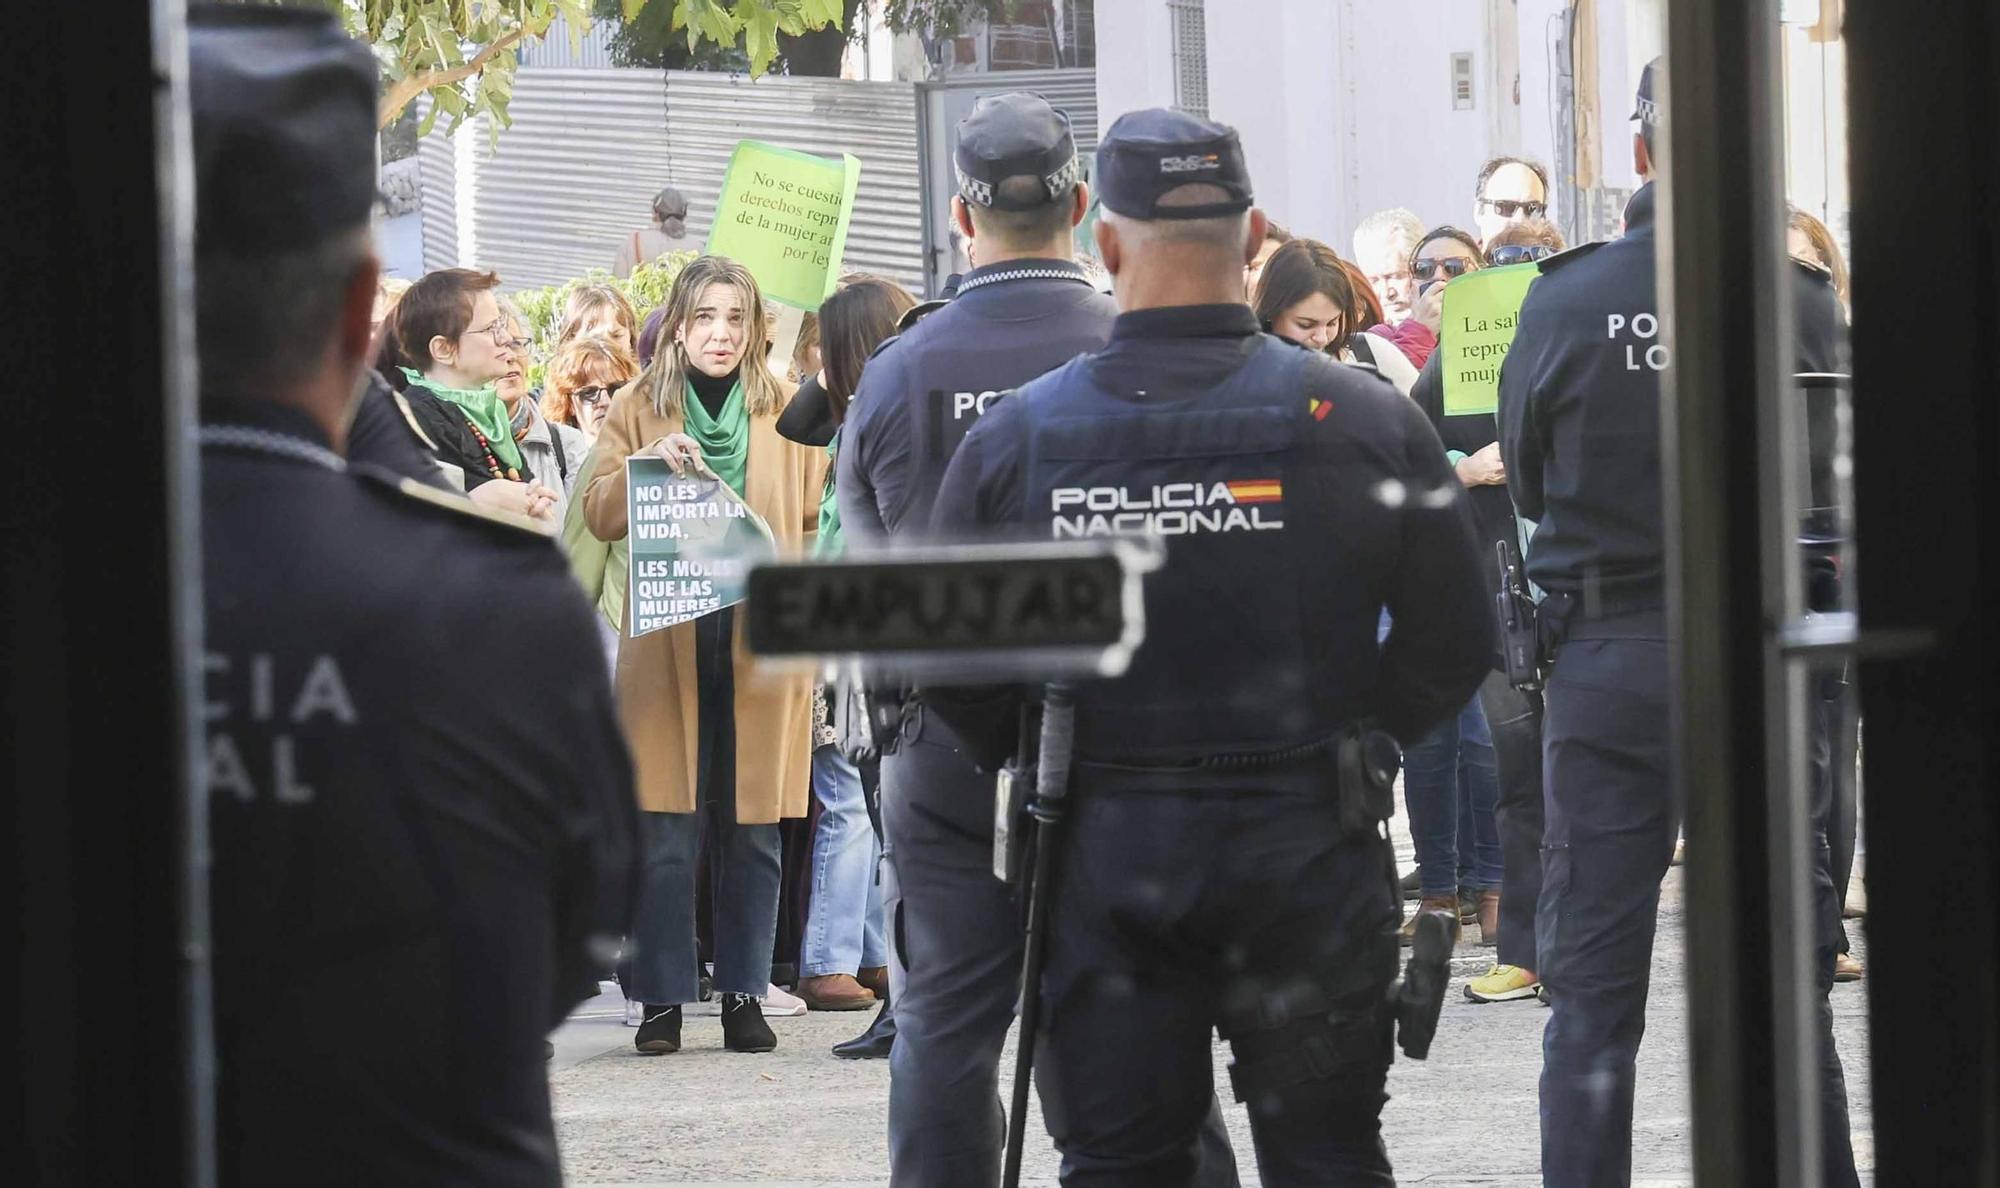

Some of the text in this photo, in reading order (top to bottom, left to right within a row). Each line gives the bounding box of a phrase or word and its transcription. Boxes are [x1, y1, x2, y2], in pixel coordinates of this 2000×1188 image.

[752, 171, 775, 188] No
[777, 179, 794, 192] se
[739, 191, 805, 216] derechos
[736, 210, 754, 225] de
[757, 214, 770, 229] la
[774, 221, 818, 241] mujer
[782, 245, 808, 260] por
[1463, 311, 1519, 333] La sal
[1607, 312, 1659, 339] PO
[1626, 344, 1671, 371] LO
[636, 484, 698, 502] NO LES
[1051, 481, 1236, 512] POLICIA
[636, 502, 746, 521] IMPORTA LA
[636, 523, 689, 540] VIDA,
[1052, 507, 1284, 539] NACIONAL
[638, 561, 668, 577] LES
[638, 580, 713, 599] QUE LAS
[639, 597, 720, 616] MUJERES
[762, 573, 1104, 635] EMPUJAR
